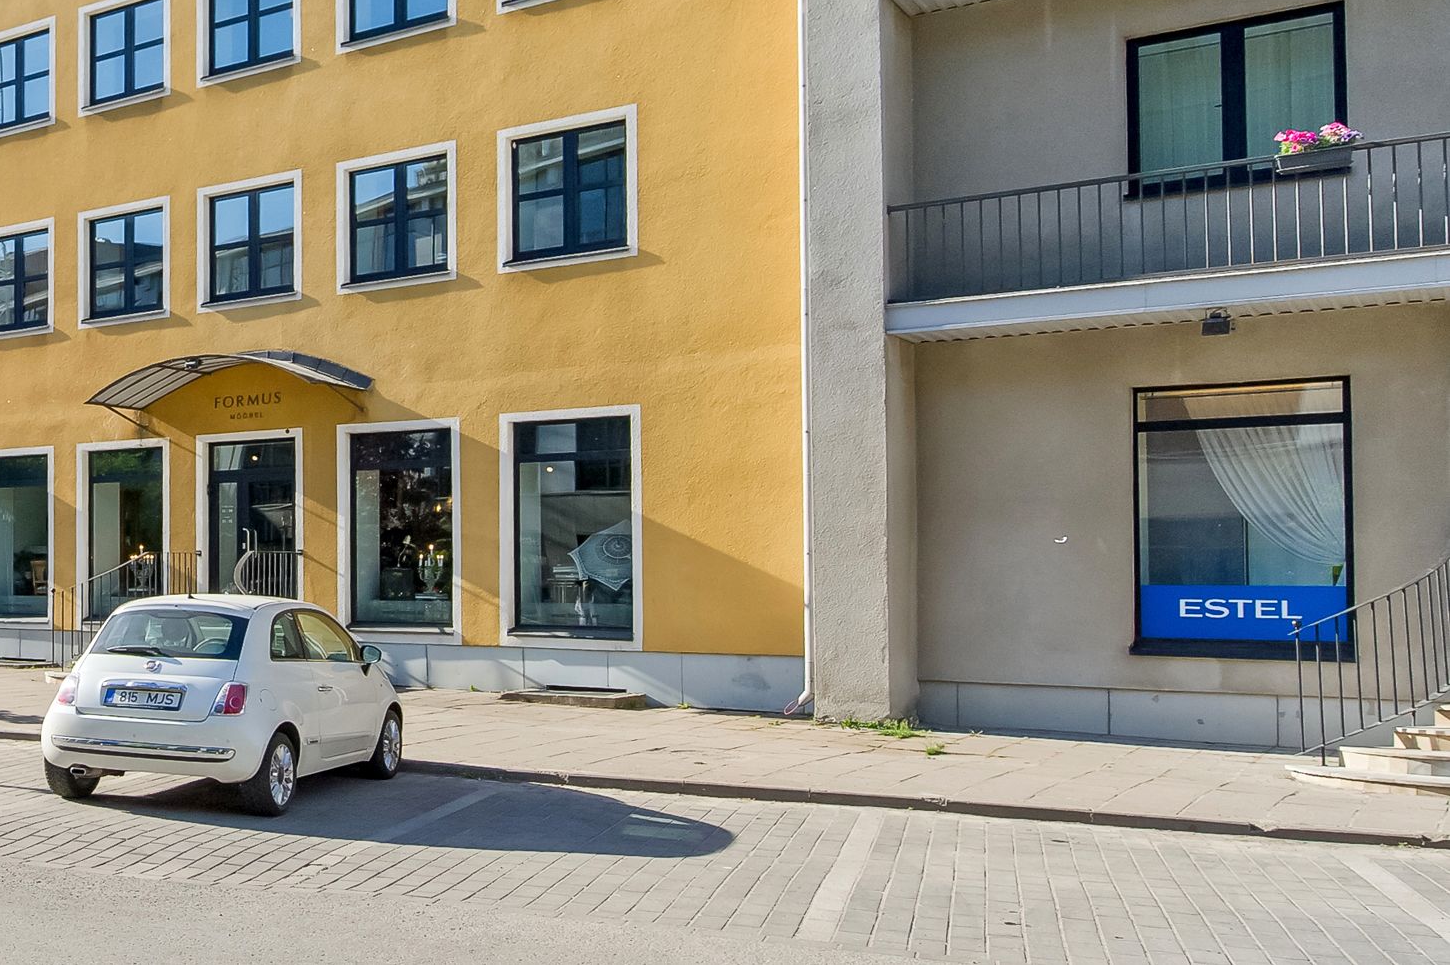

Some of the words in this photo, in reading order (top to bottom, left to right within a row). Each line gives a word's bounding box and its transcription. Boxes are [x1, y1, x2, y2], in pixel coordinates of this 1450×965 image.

[214, 391, 282, 409] FORMUS
[1179, 598, 1302, 619] ESTEL
[119, 691, 138, 703] 815
[146, 692, 175, 705] MJS
